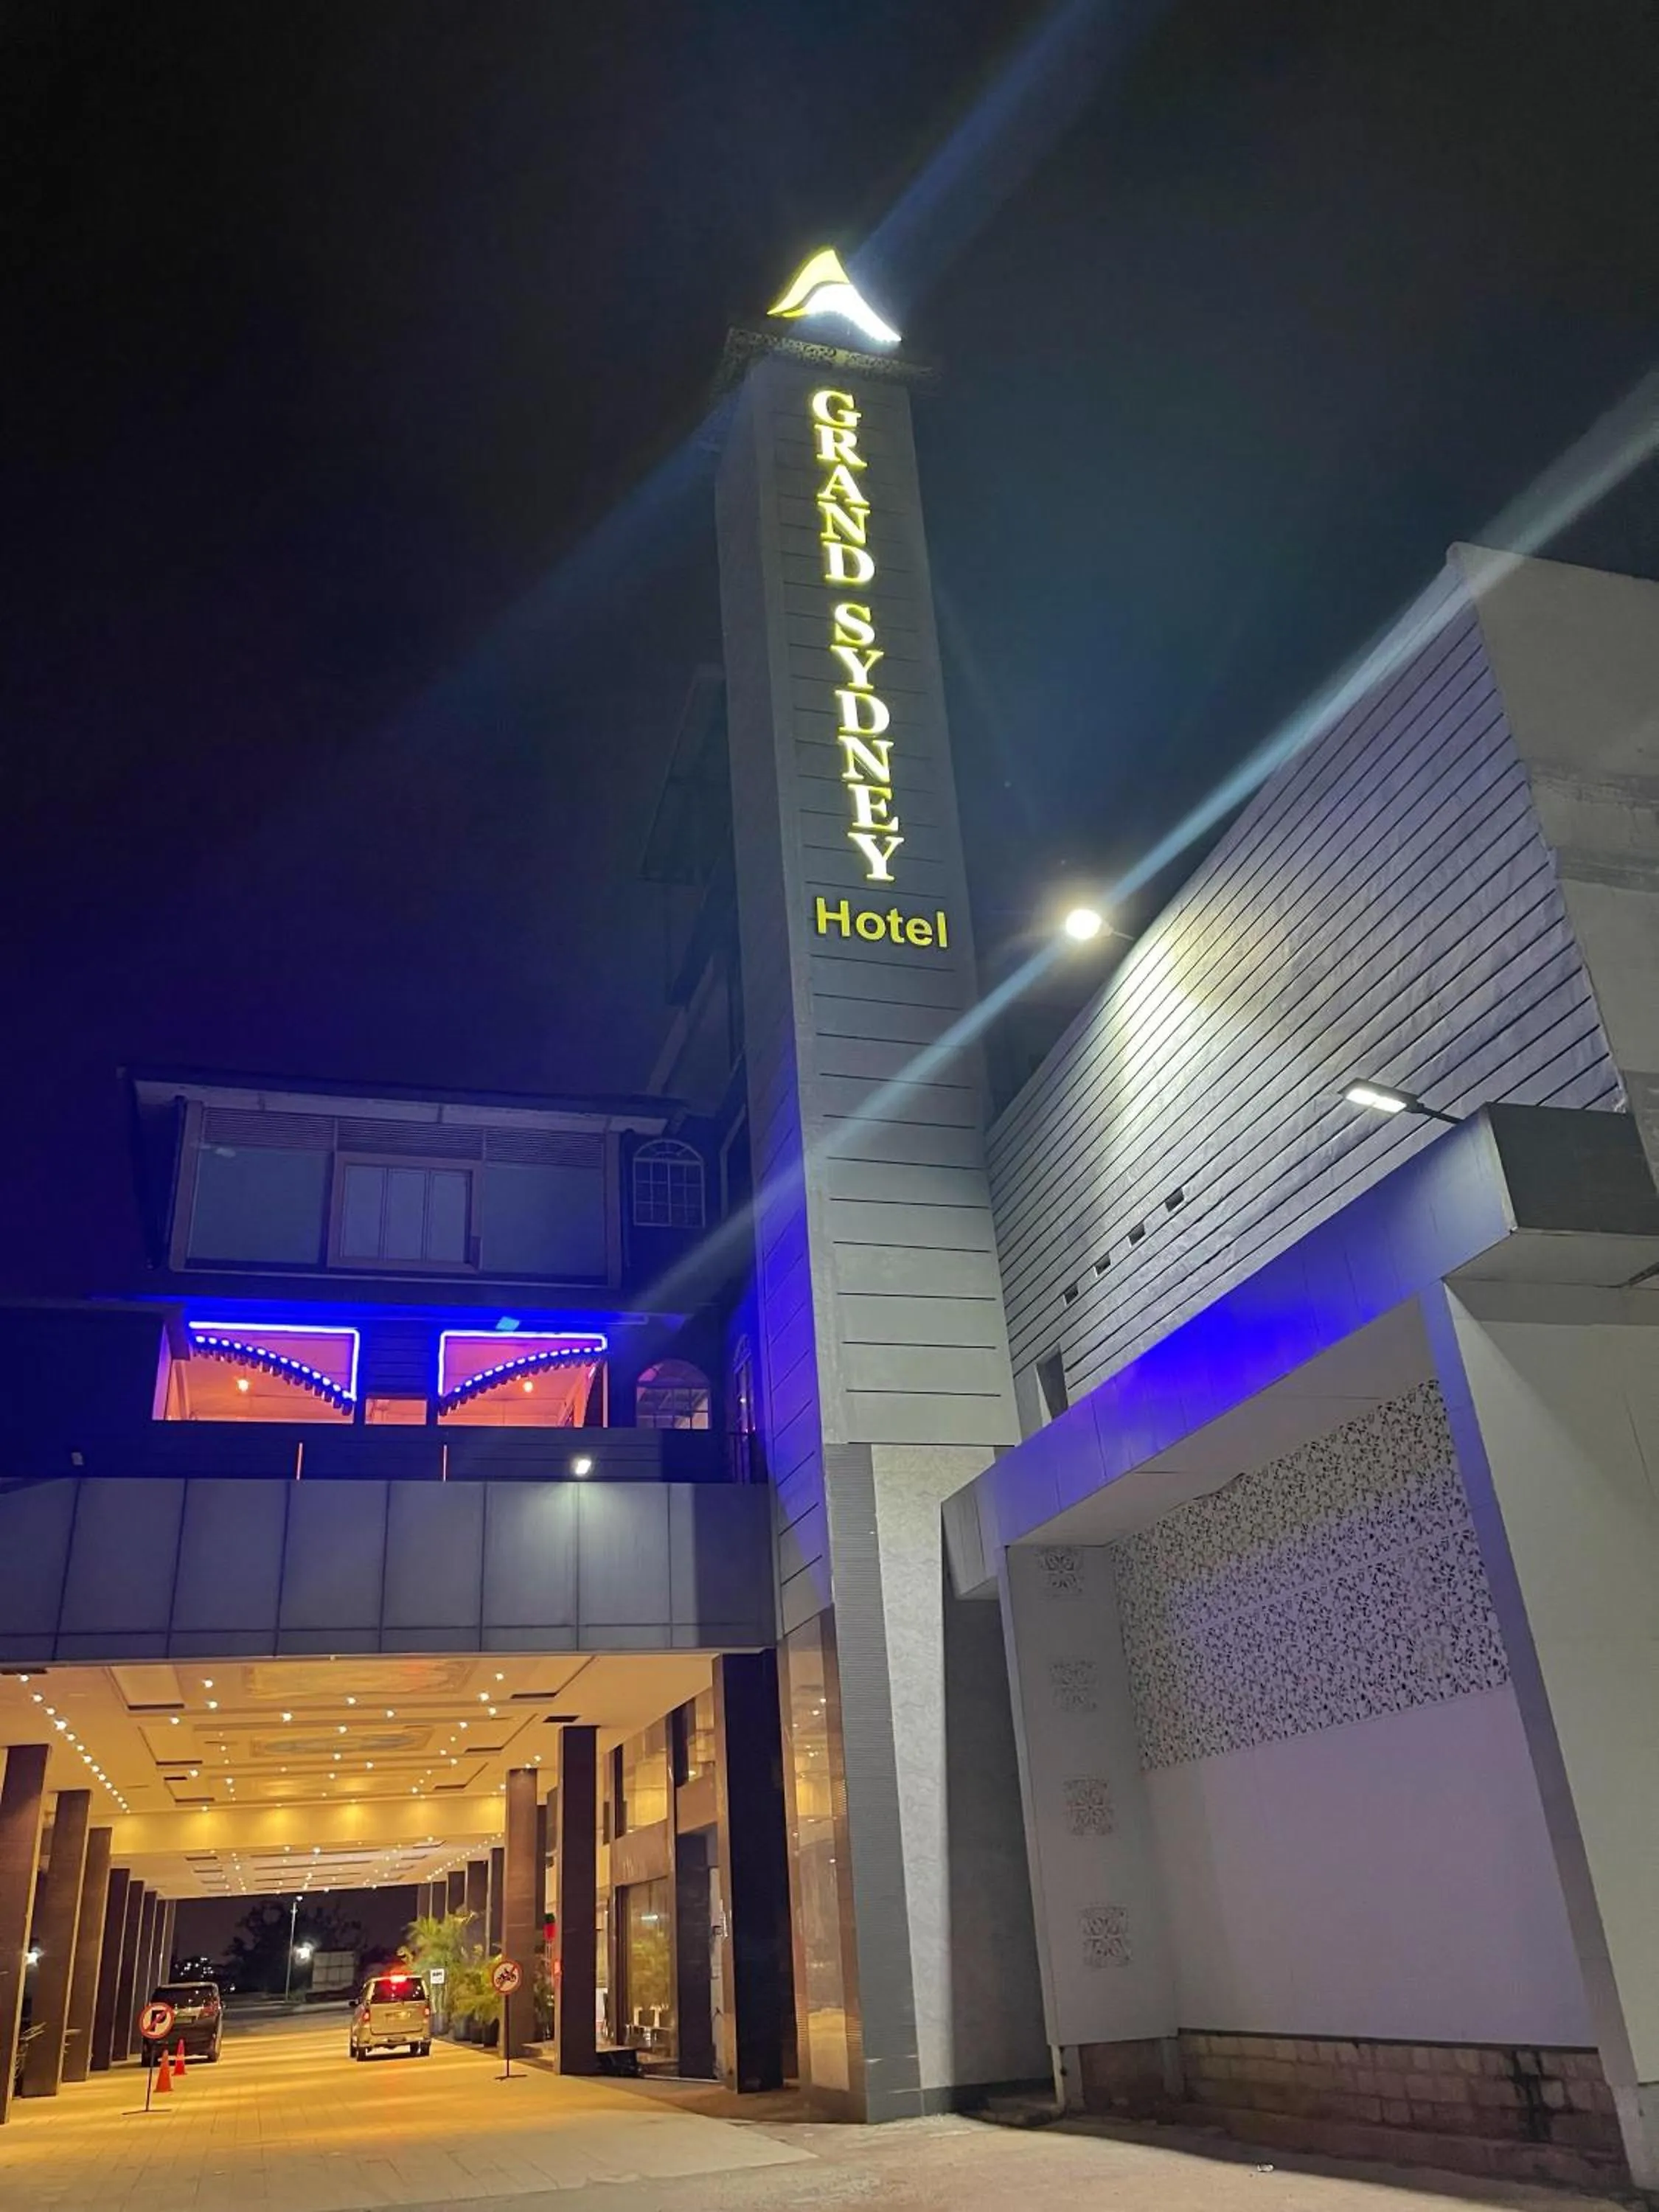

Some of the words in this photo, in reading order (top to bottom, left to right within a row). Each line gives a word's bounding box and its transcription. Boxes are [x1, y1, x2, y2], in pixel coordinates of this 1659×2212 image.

[812, 390, 874, 584] GRAND
[830, 602, 905, 881] SYDNEY
[816, 897, 947, 947] Hotel
[150, 2010, 167, 2031] P
